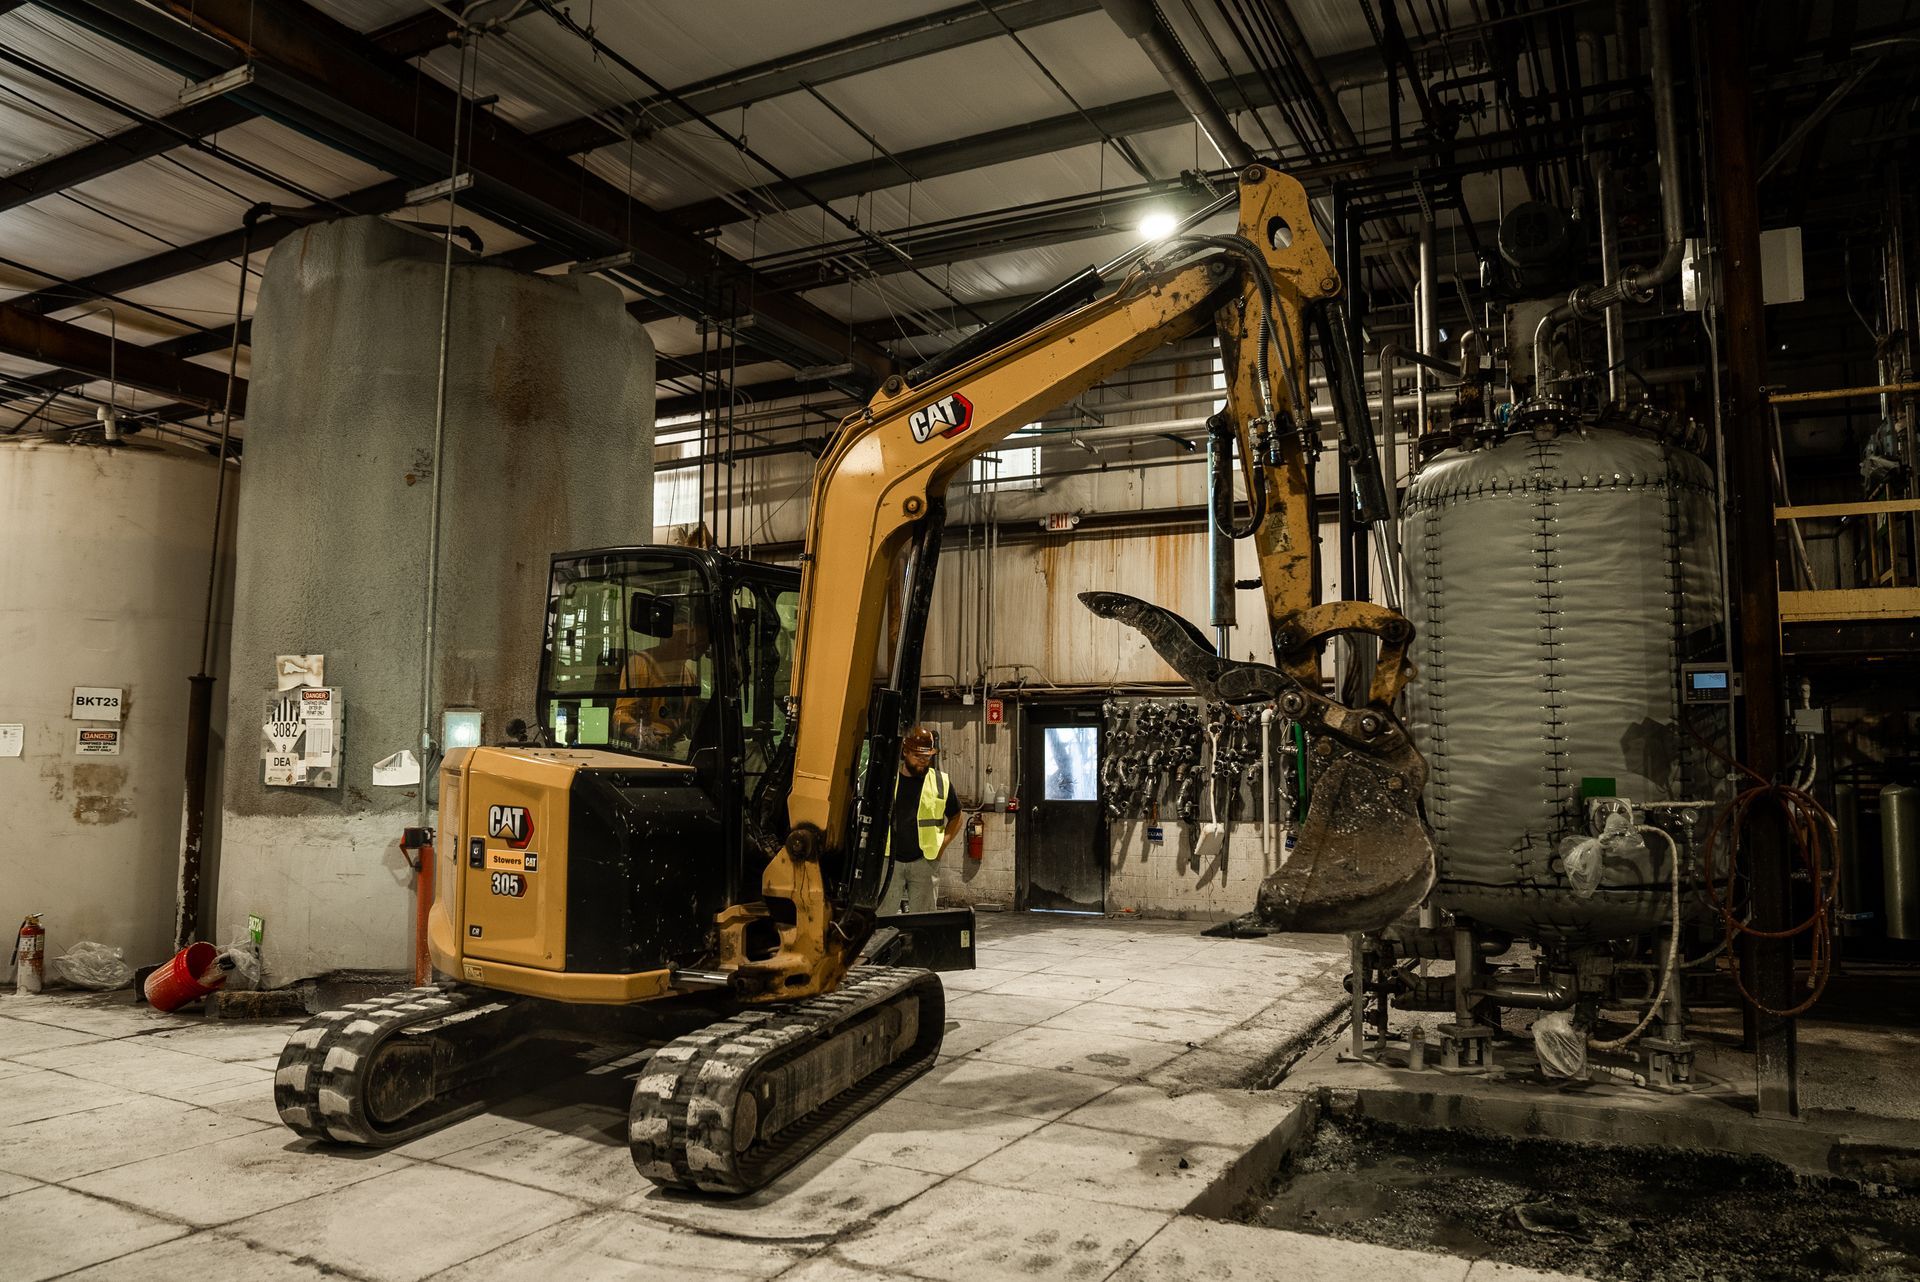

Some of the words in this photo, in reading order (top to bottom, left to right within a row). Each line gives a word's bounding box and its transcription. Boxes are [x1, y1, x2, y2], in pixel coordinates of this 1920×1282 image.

[909, 395, 957, 442] CAT
[1050, 512, 1069, 529] EXIT
[76, 696, 119, 707] BKT23
[273, 722, 298, 738] 3082
[273, 757, 291, 767] DEA
[490, 806, 524, 839] CAT
[493, 856, 522, 865] Stowers
[525, 857, 536, 867] CAT
[492, 873, 519, 896] 305
